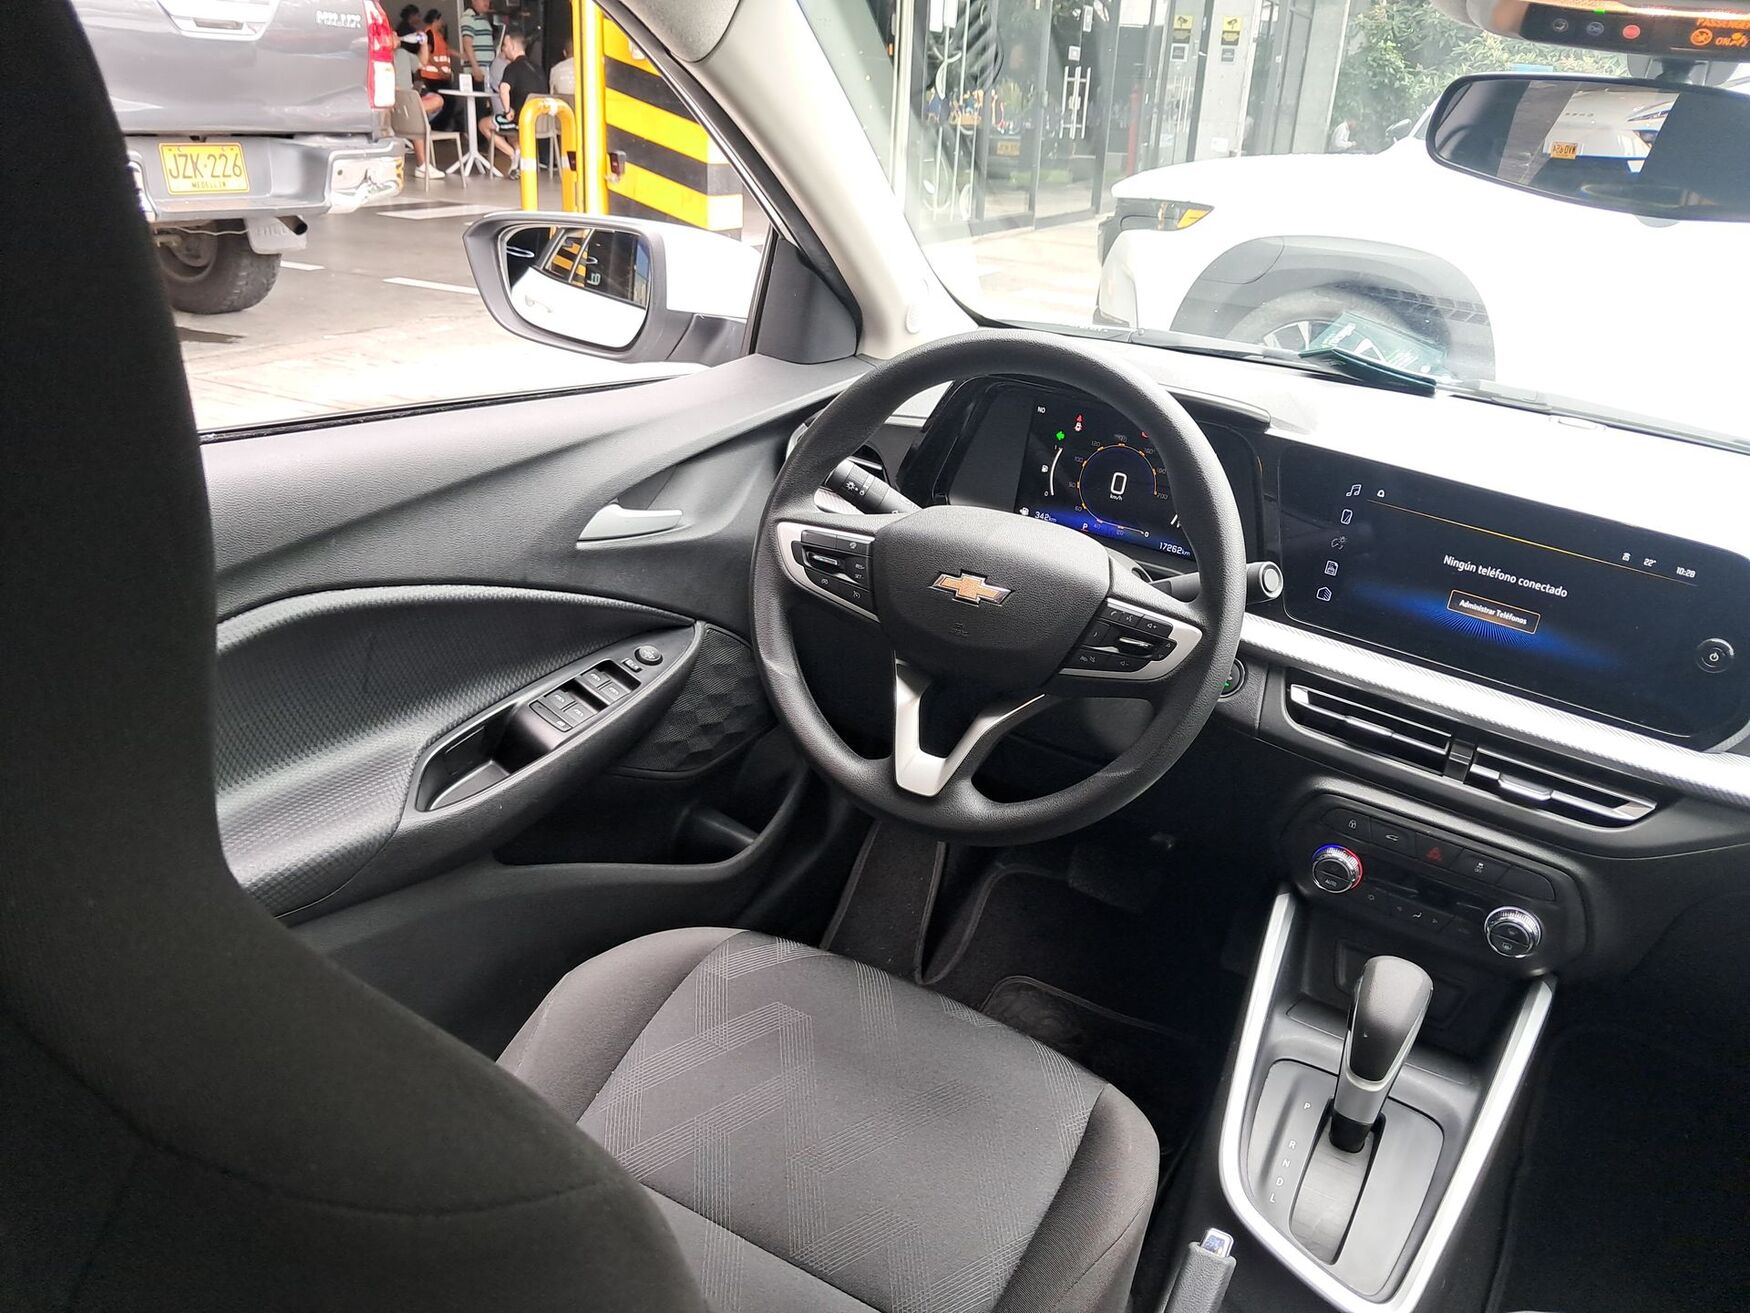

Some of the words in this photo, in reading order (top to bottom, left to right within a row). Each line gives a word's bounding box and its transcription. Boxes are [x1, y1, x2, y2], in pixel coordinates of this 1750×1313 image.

[1110, 472, 1127, 494] 0
[1443, 555, 1476, 572] Ningún
[1477, 565, 1517, 584] teléfono
[1518, 577, 1568, 598] conectado
[1459, 599, 1496, 616] Administrar
[1496, 609, 1527, 625] Teléfonos
[1288, 1140, 1297, 1149] R
[1282, 1159, 1290, 1168] N
[1276, 1177, 1283, 1186] D
[1270, 1193, 1276, 1203] L
